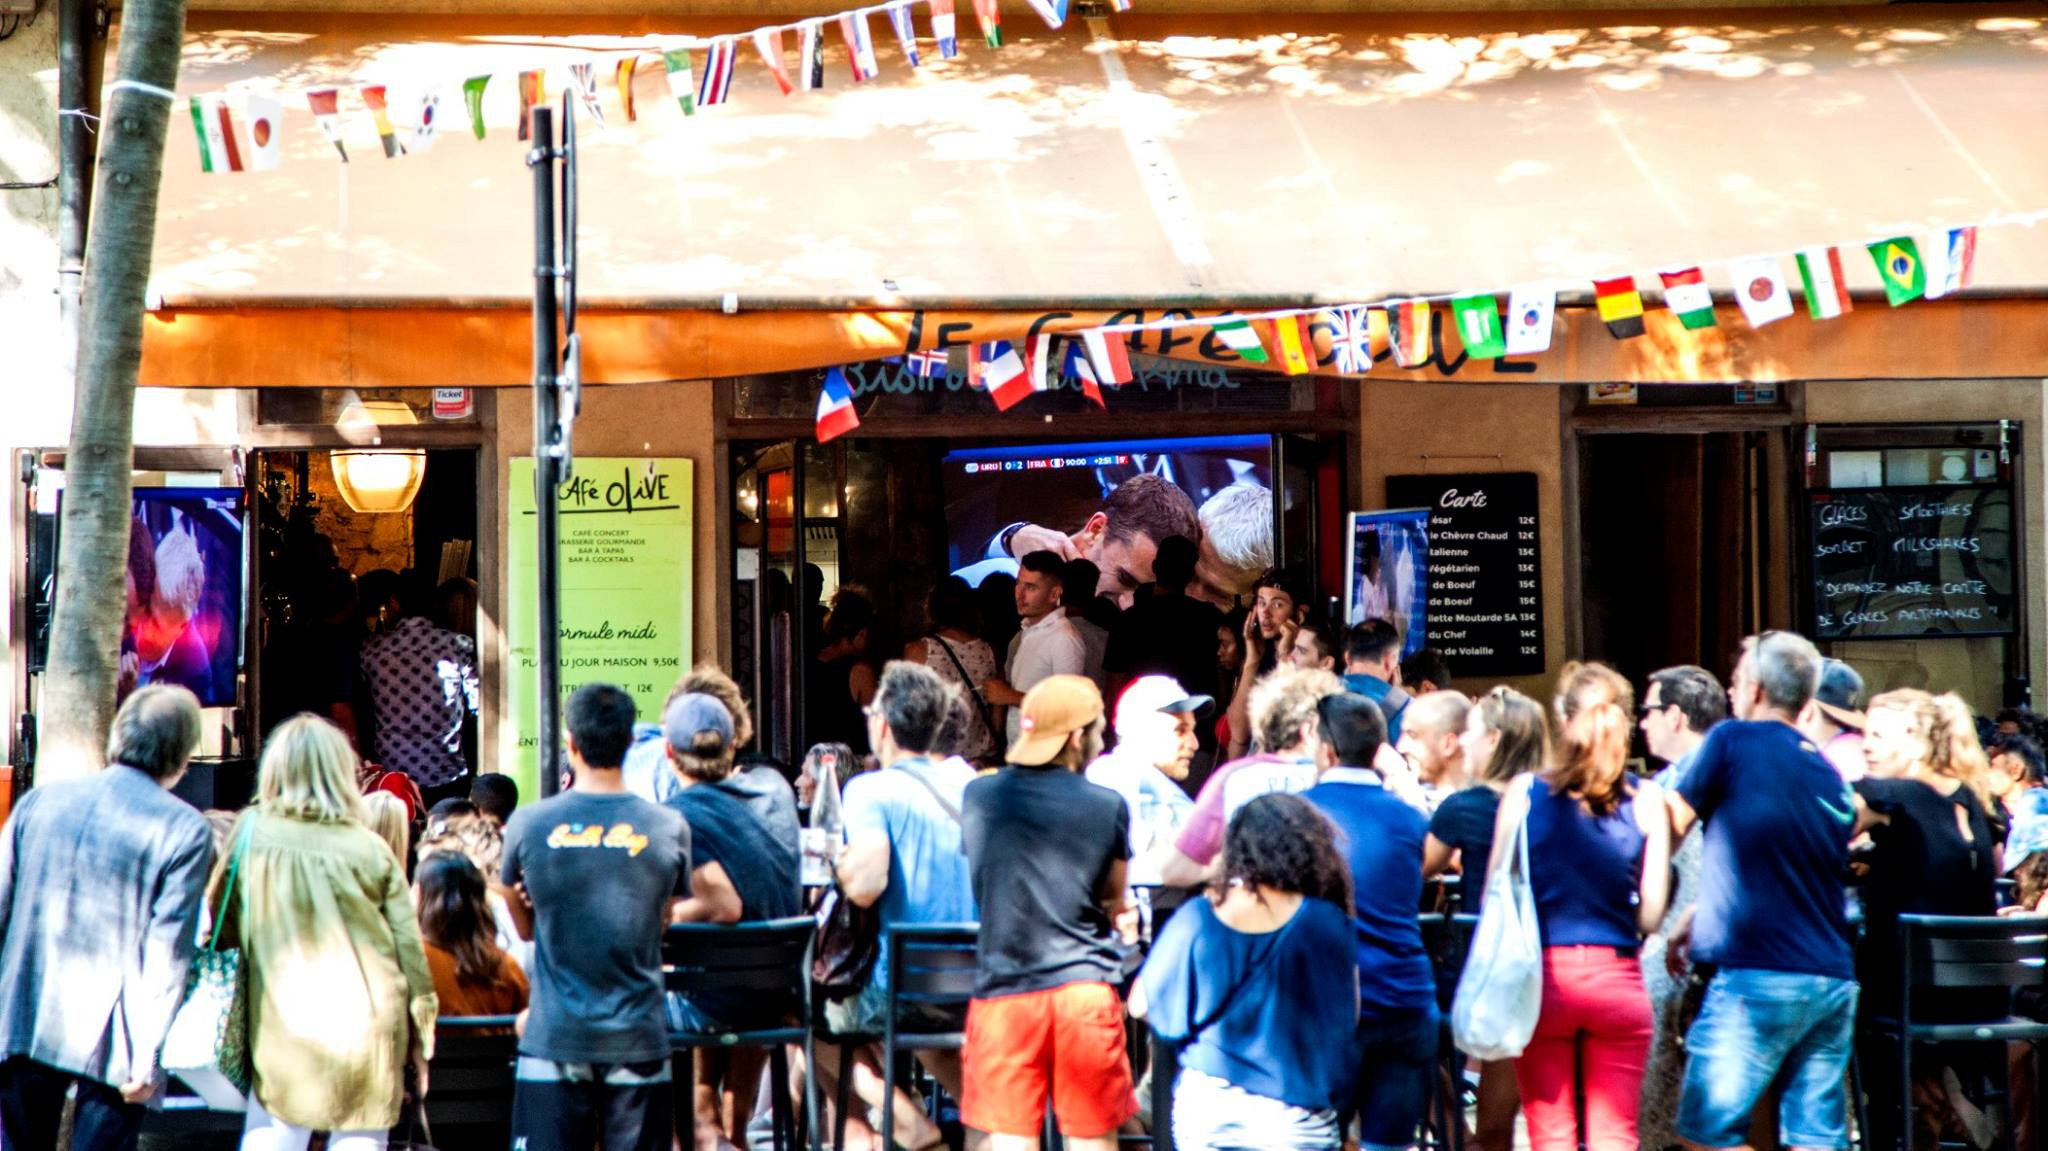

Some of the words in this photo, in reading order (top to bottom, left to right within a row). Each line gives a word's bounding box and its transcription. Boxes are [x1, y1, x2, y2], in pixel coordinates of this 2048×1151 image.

[1066, 458, 1086, 466] 90:00
[1440, 488, 1488, 508] Carte
[1820, 504, 1868, 525] GLACES
[1899, 503, 1973, 519] SMOOTHIES
[1431, 515, 1452, 524] ésar
[1518, 516, 1535, 524] 12€
[593, 529, 630, 537] CONCERT
[1441, 531, 1475, 539] Chèvre
[1477, 531, 1508, 540] Chaud
[1518, 531, 1535, 539] 12€
[1893, 538, 1980, 552] MILKSHAKES
[1429, 547, 1469, 556] talienne
[1433, 581, 1445, 589] de
[1447, 580, 1476, 589] Boeuf
[1943, 580, 1987, 595] CARTE
[1429, 597, 1442, 606] de
[1444, 597, 1473, 606] Boeuf
[1455, 613, 1503, 622] Moutarde
[559, 620, 614, 639] ormule
[617, 620, 656, 639] midi
[1428, 631, 1441, 639] du
[1443, 630, 1467, 639] Chef
[1520, 629, 1537, 638] 14€
[1444, 647, 1457, 656] de
[1459, 646, 1494, 656] Volaille
[1520, 646, 1537, 655] 12€
[571, 658, 599, 669] JOUR
[603, 658, 647, 667] MAISON
[637, 684, 652, 692] 12€
